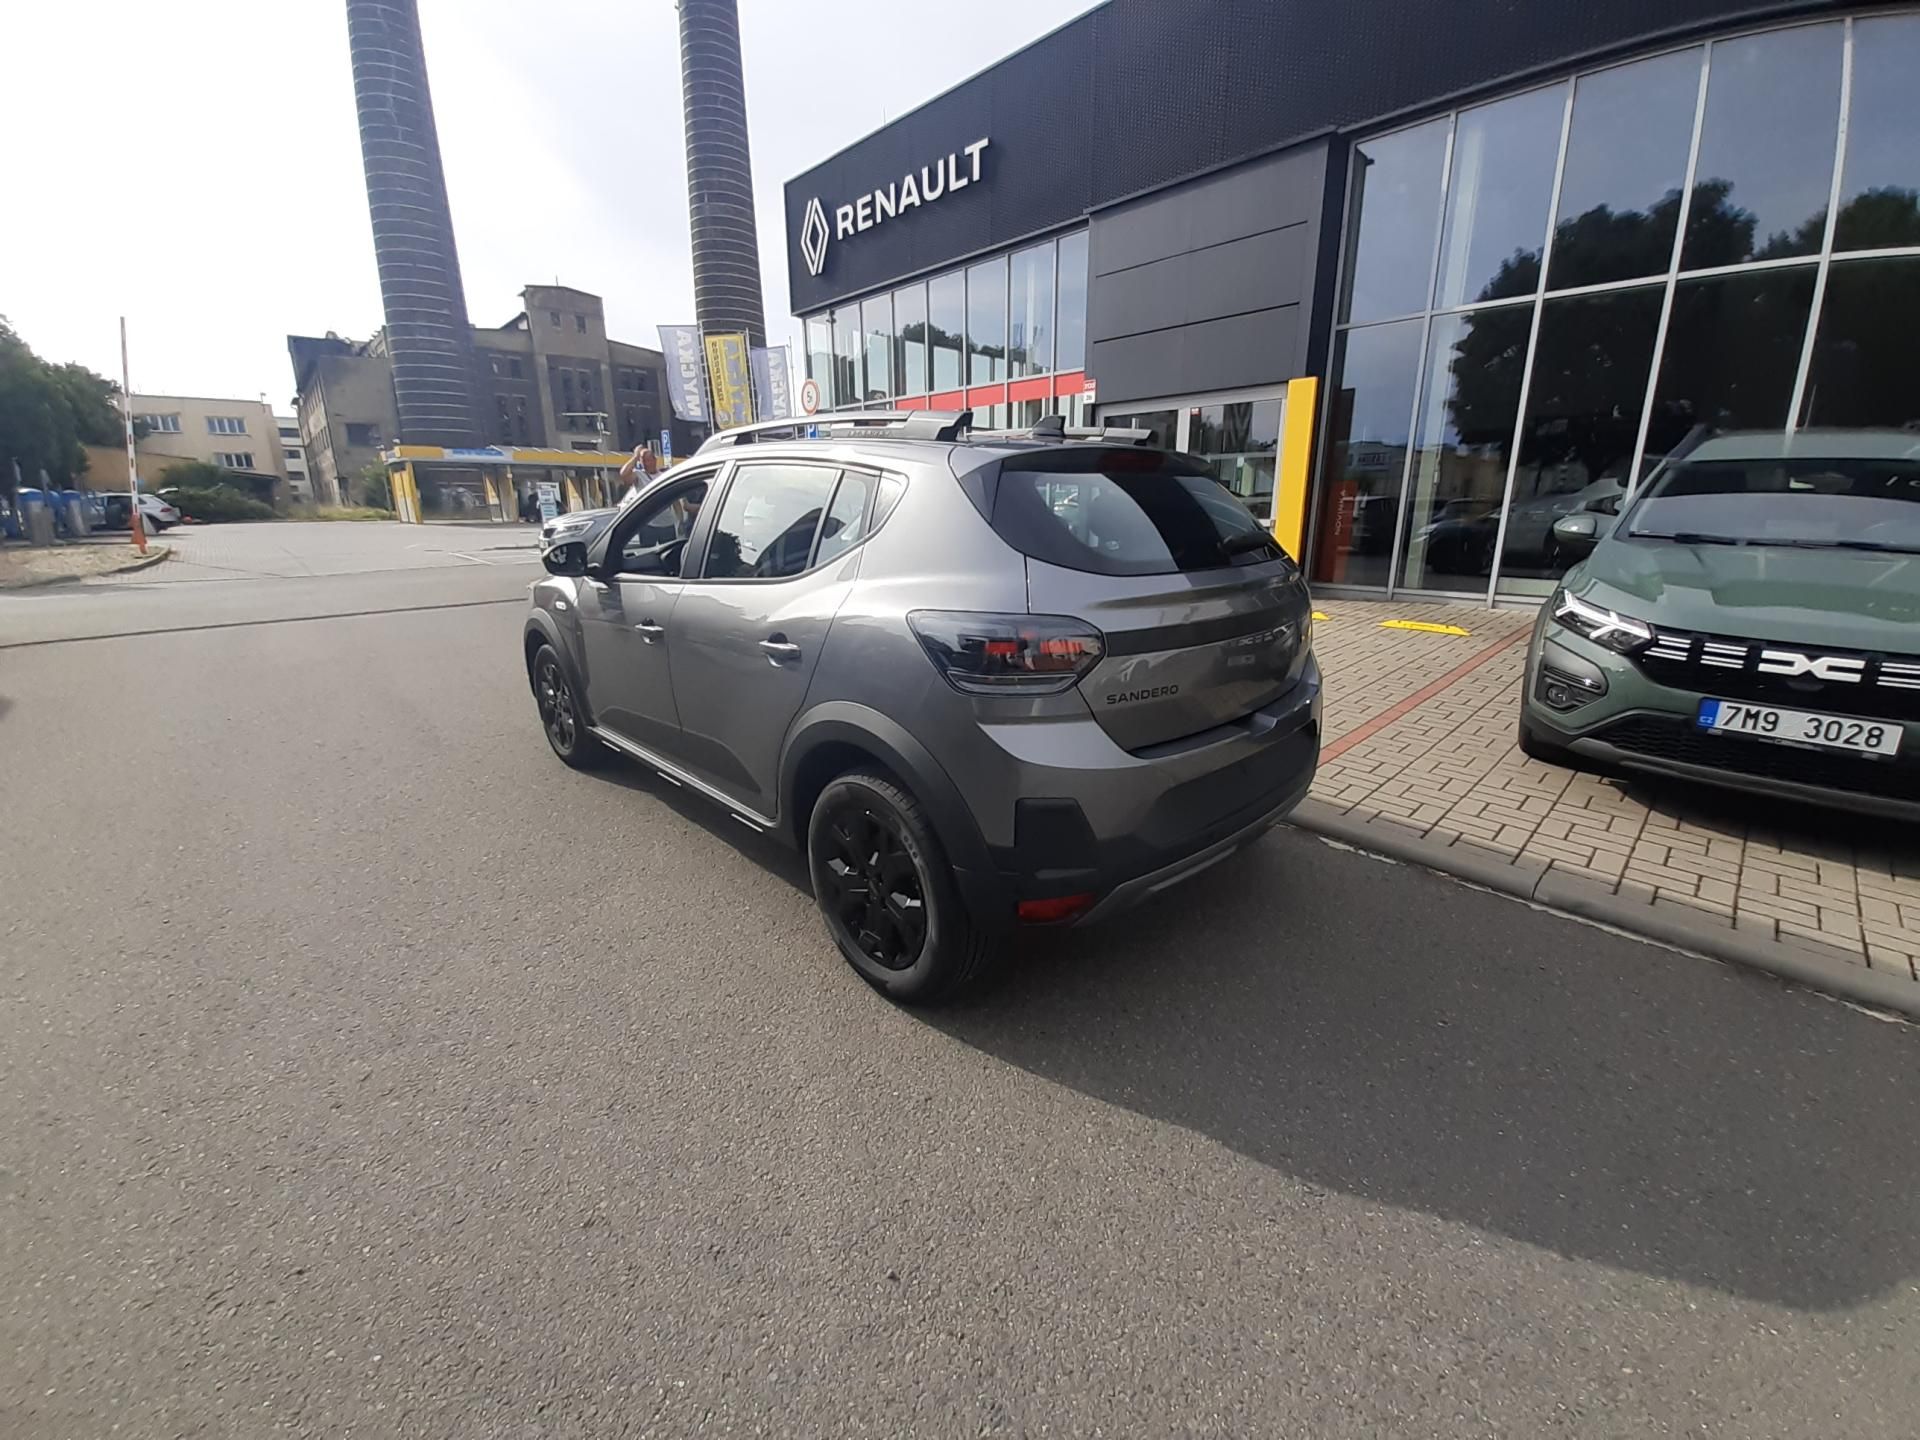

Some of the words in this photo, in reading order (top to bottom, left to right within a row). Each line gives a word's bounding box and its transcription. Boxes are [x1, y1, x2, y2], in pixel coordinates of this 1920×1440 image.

[836, 137, 989, 240] RENAULT
[1106, 684, 1179, 705] SANDERO
[1698, 715, 1714, 724] CZ
[1721, 705, 1780, 732] 7M9
[1803, 717, 1885, 748] 3028
